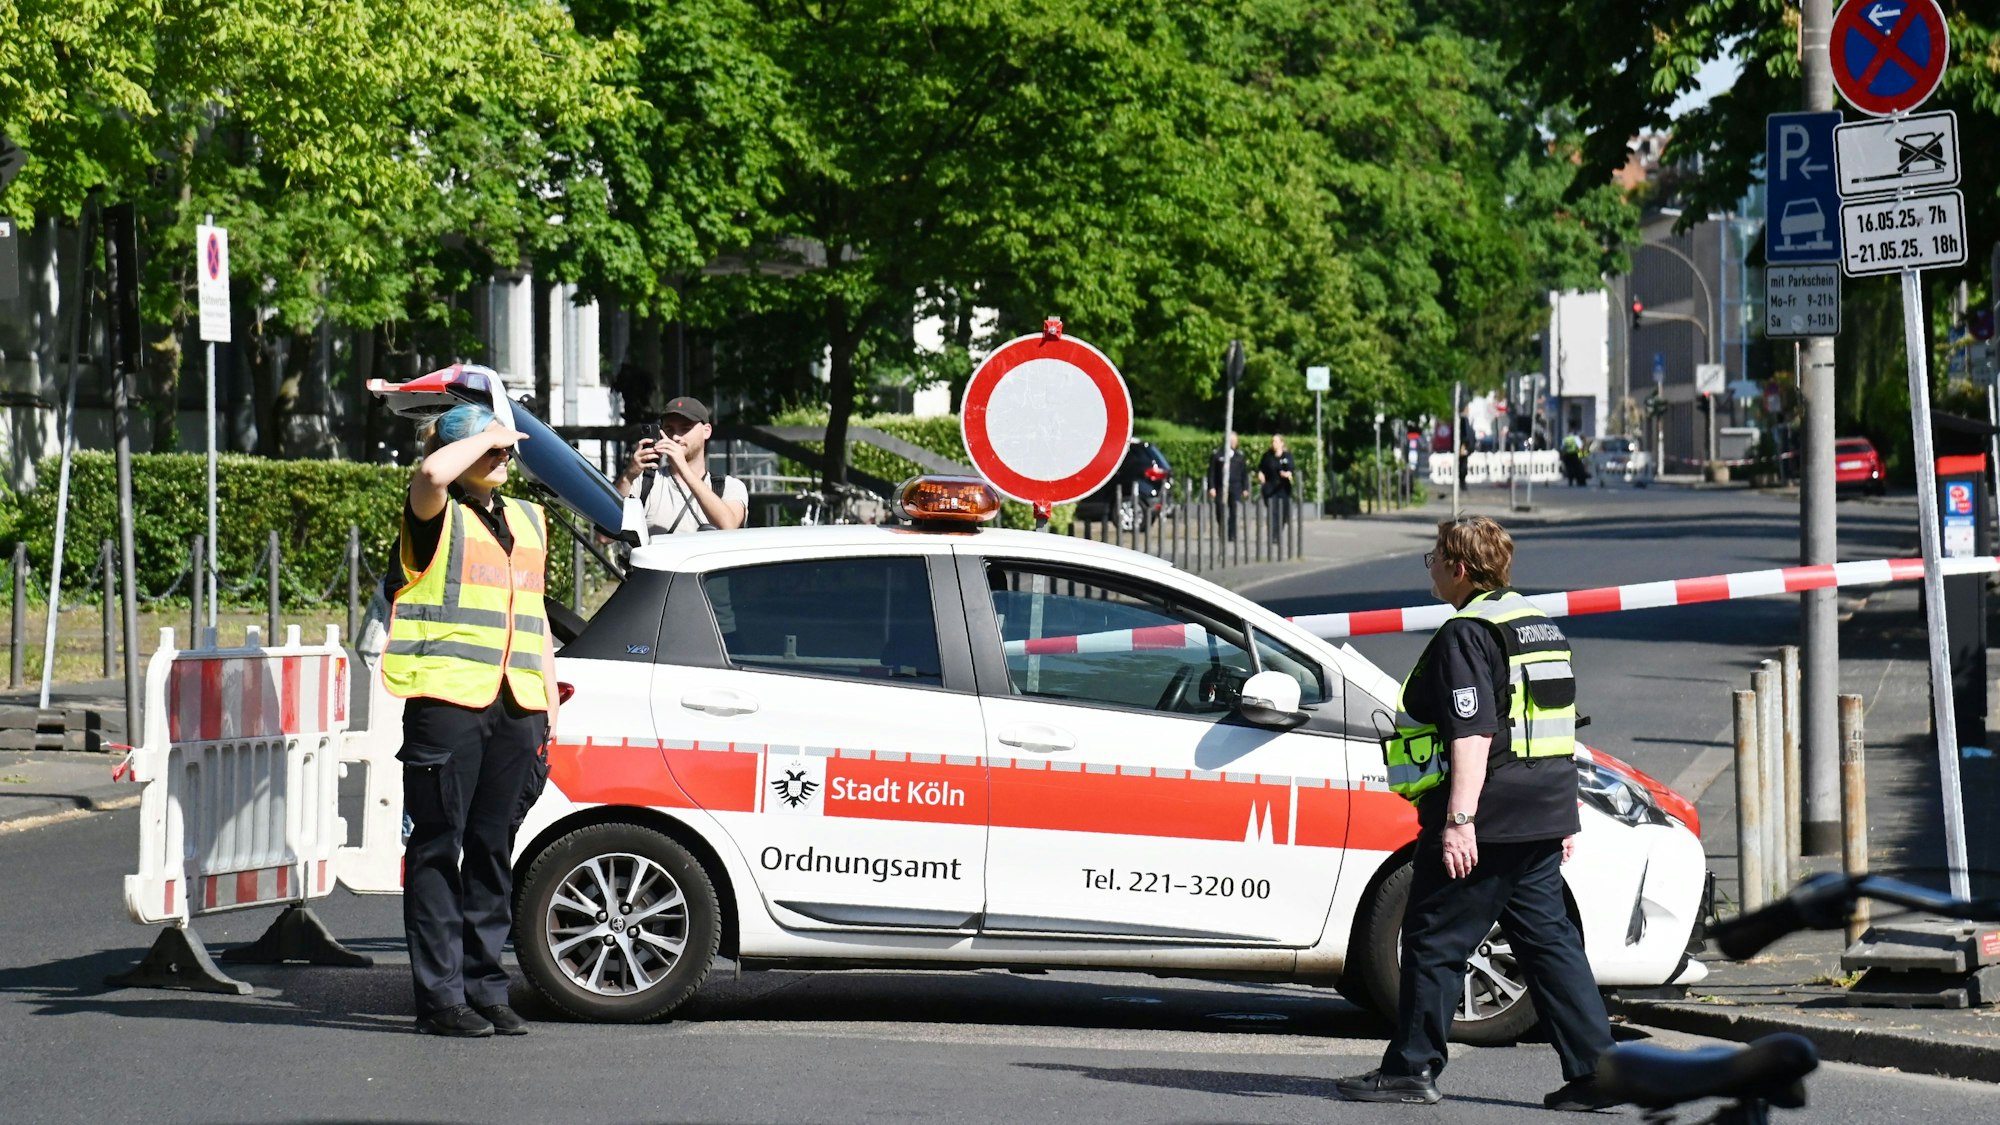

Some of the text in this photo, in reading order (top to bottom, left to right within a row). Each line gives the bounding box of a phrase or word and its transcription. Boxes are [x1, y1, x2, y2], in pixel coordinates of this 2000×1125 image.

[1780, 125, 1810, 181] P
[1857, 205, 1947, 233] 16.05.25, 7h
[1932, 235, 1958, 254] 18h
[1770, 273, 1834, 288] mit Parkschein
[1770, 293, 1796, 308] Mo-Fr
[1771, 314, 1781, 327] Sa
[831, 777, 965, 806] Stadt Köln
[760, 846, 962, 883] Ordnungsamt
[1081, 868, 1271, 899] Tel. 221-320 00
